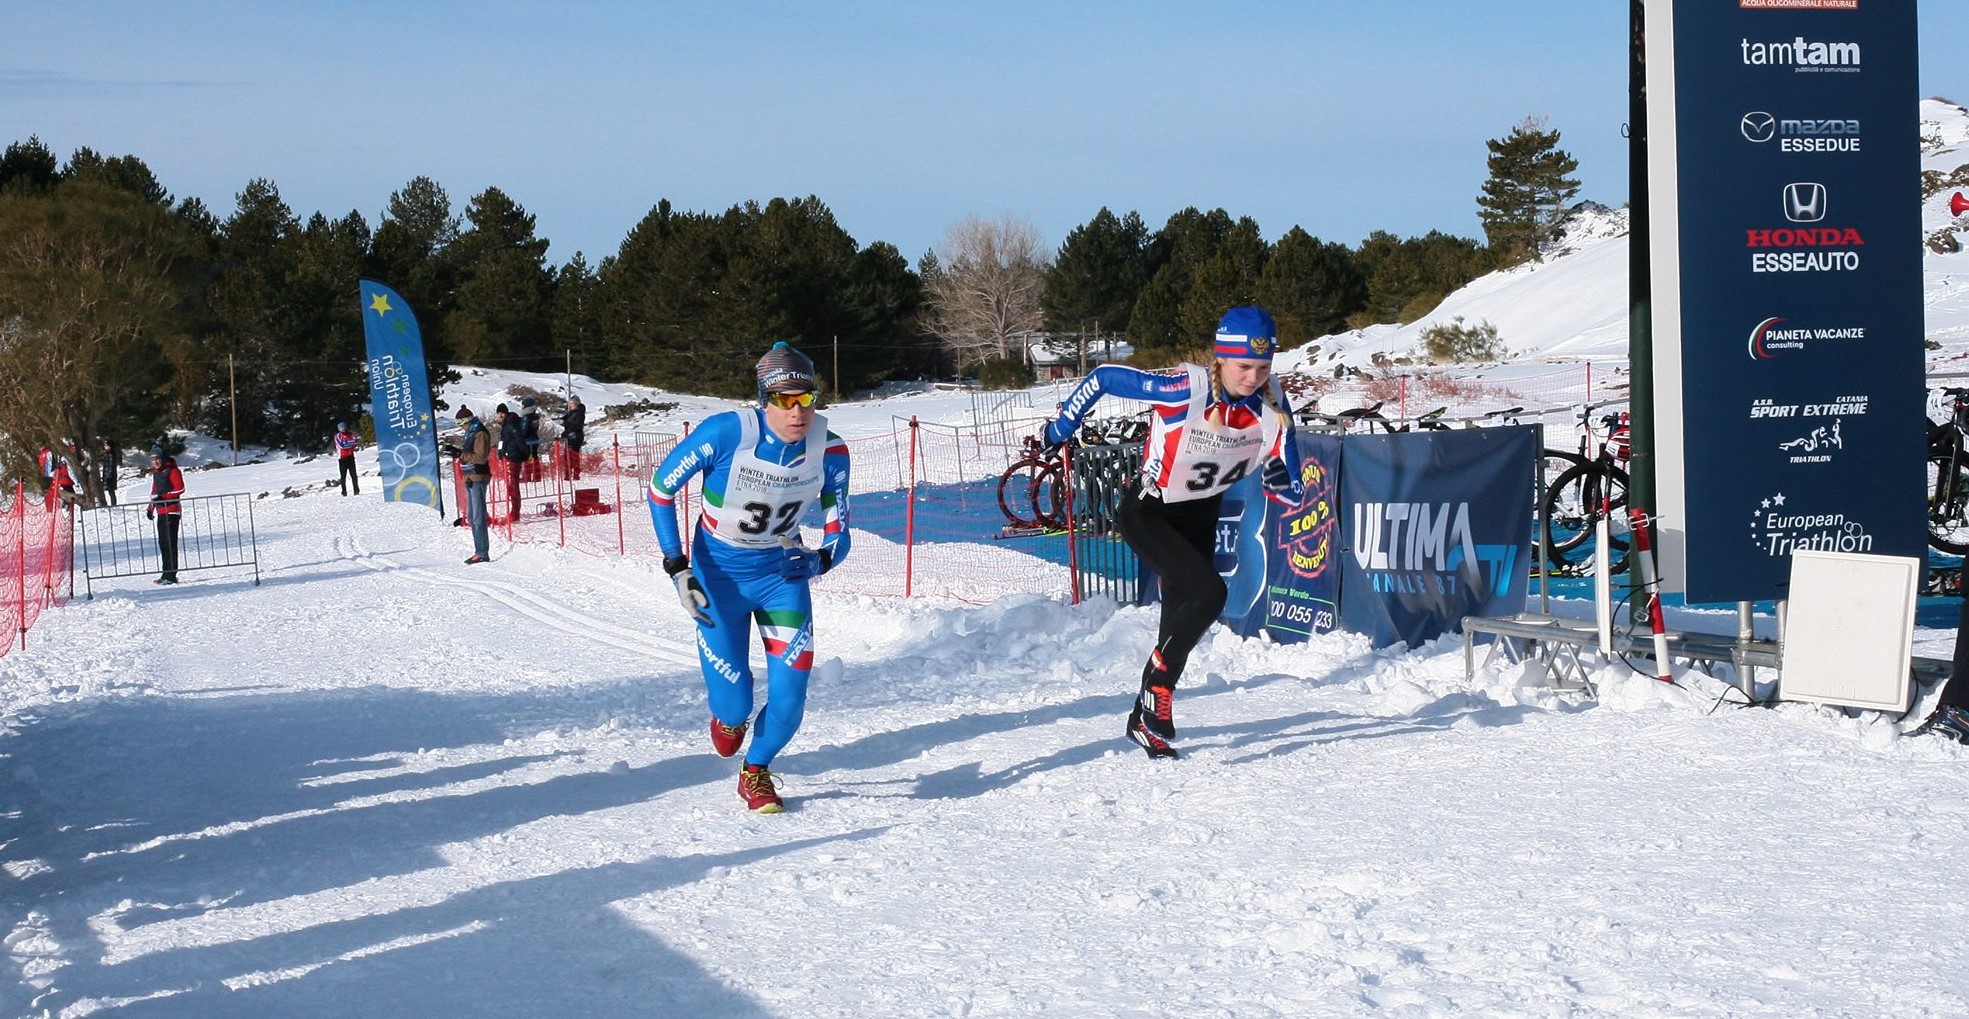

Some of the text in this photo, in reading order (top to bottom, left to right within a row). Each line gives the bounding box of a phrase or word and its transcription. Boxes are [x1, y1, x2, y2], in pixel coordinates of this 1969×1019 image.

[1823, 0, 1857, 8] NATURALE
[1741, 37, 1860, 65] tamtam
[1781, 138, 1860, 152] ESSEDUE
[1745, 228, 1865, 247] HONDA
[1752, 251, 1859, 273] ESSEAUTO
[1766, 328, 1864, 341] PIANETA VACANZE
[1766, 341, 1804, 350] consulting
[1063, 374, 1100, 421] RUSSIA
[1750, 403, 1868, 418] SPORT EXTREME
[1188, 435, 1221, 448] EUROPEAN
[1190, 428, 1214, 440] WINTER
[1186, 442, 1202, 452] ETNA
[1789, 455, 1832, 464] TRIATHLON
[663, 450, 700, 489] sportful
[740, 466, 765, 479] WINTER
[1185, 458, 1251, 492] 34
[736, 480, 752, 489] ETNA
[738, 473, 772, 487] EUROPEAN
[736, 500, 804, 536] 32
[1766, 513, 1844, 531] European
[1354, 502, 1483, 598] ULTIMA
[1766, 529, 1873, 556] Triathlon
[1366, 573, 1457, 595] ANALE 87
[1271, 600, 1332, 629] 00 055 233
